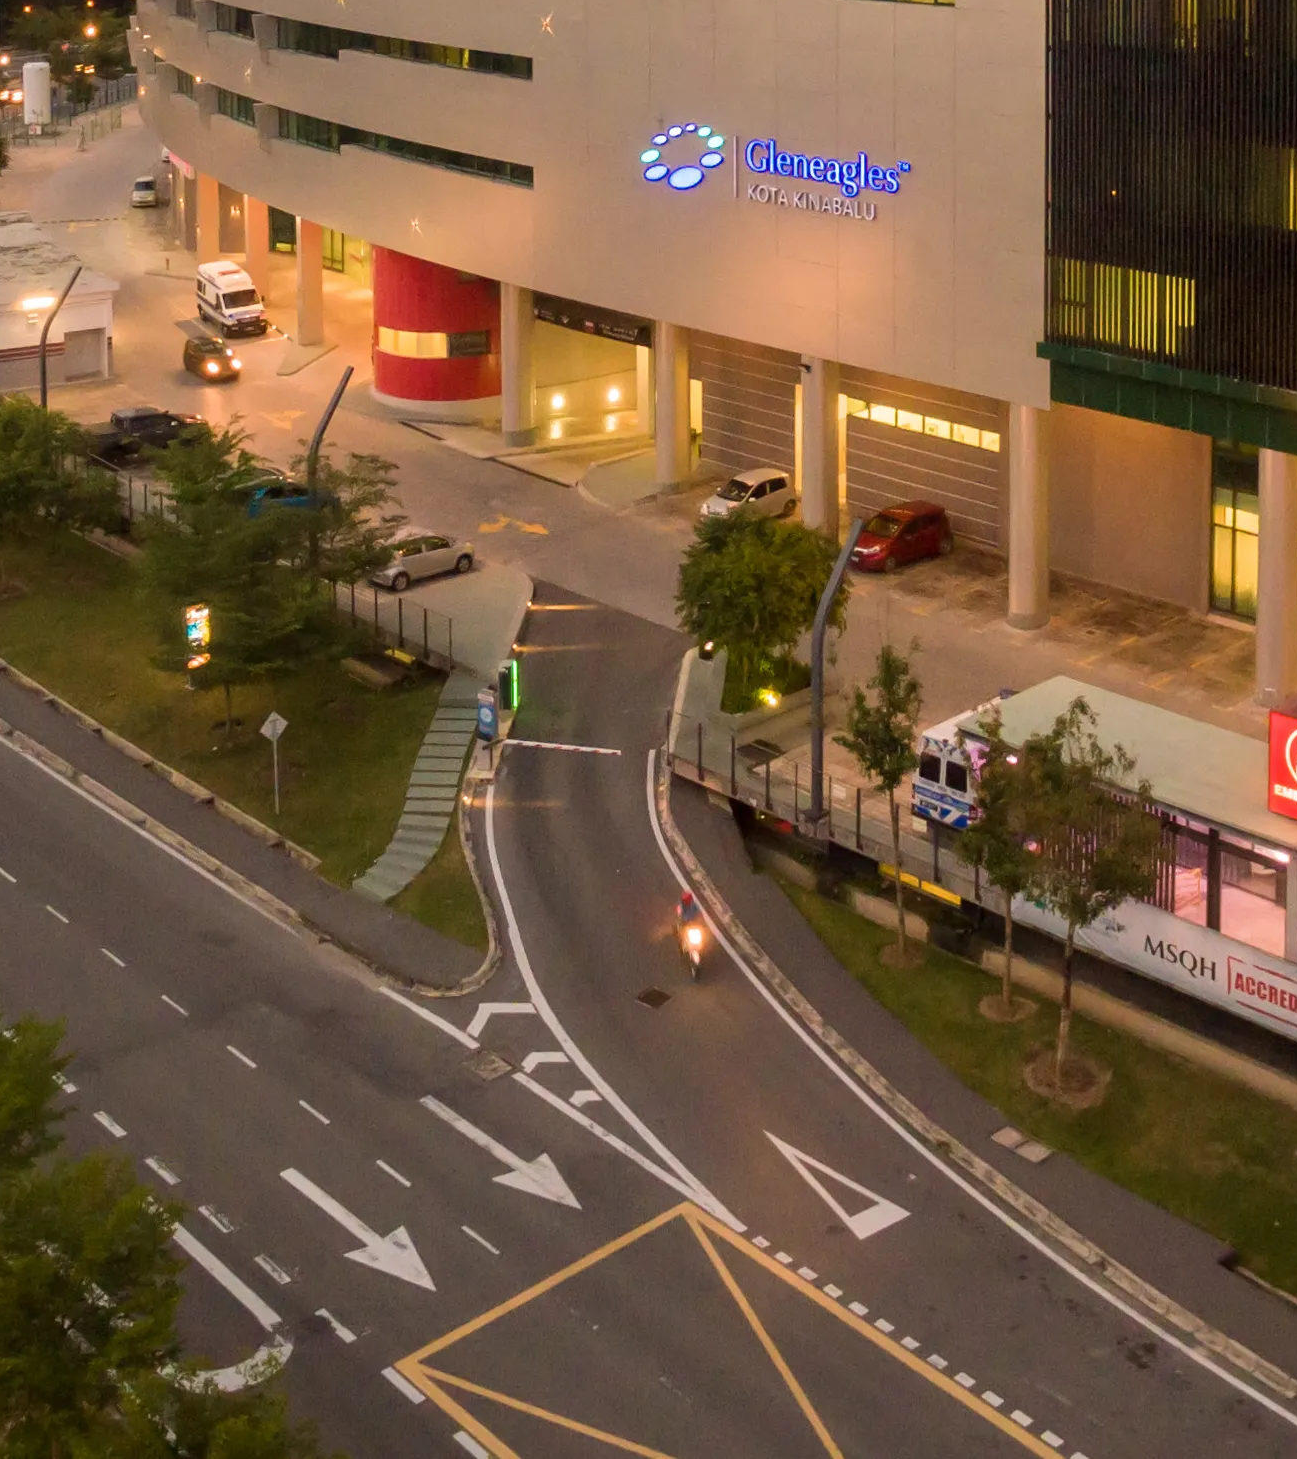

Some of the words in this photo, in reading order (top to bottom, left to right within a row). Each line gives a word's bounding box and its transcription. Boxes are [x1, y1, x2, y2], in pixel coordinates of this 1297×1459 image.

[747, 184, 788, 207] KOTA
[793, 191, 876, 221] KINABALU
[1143, 934, 1217, 982] MSQH
